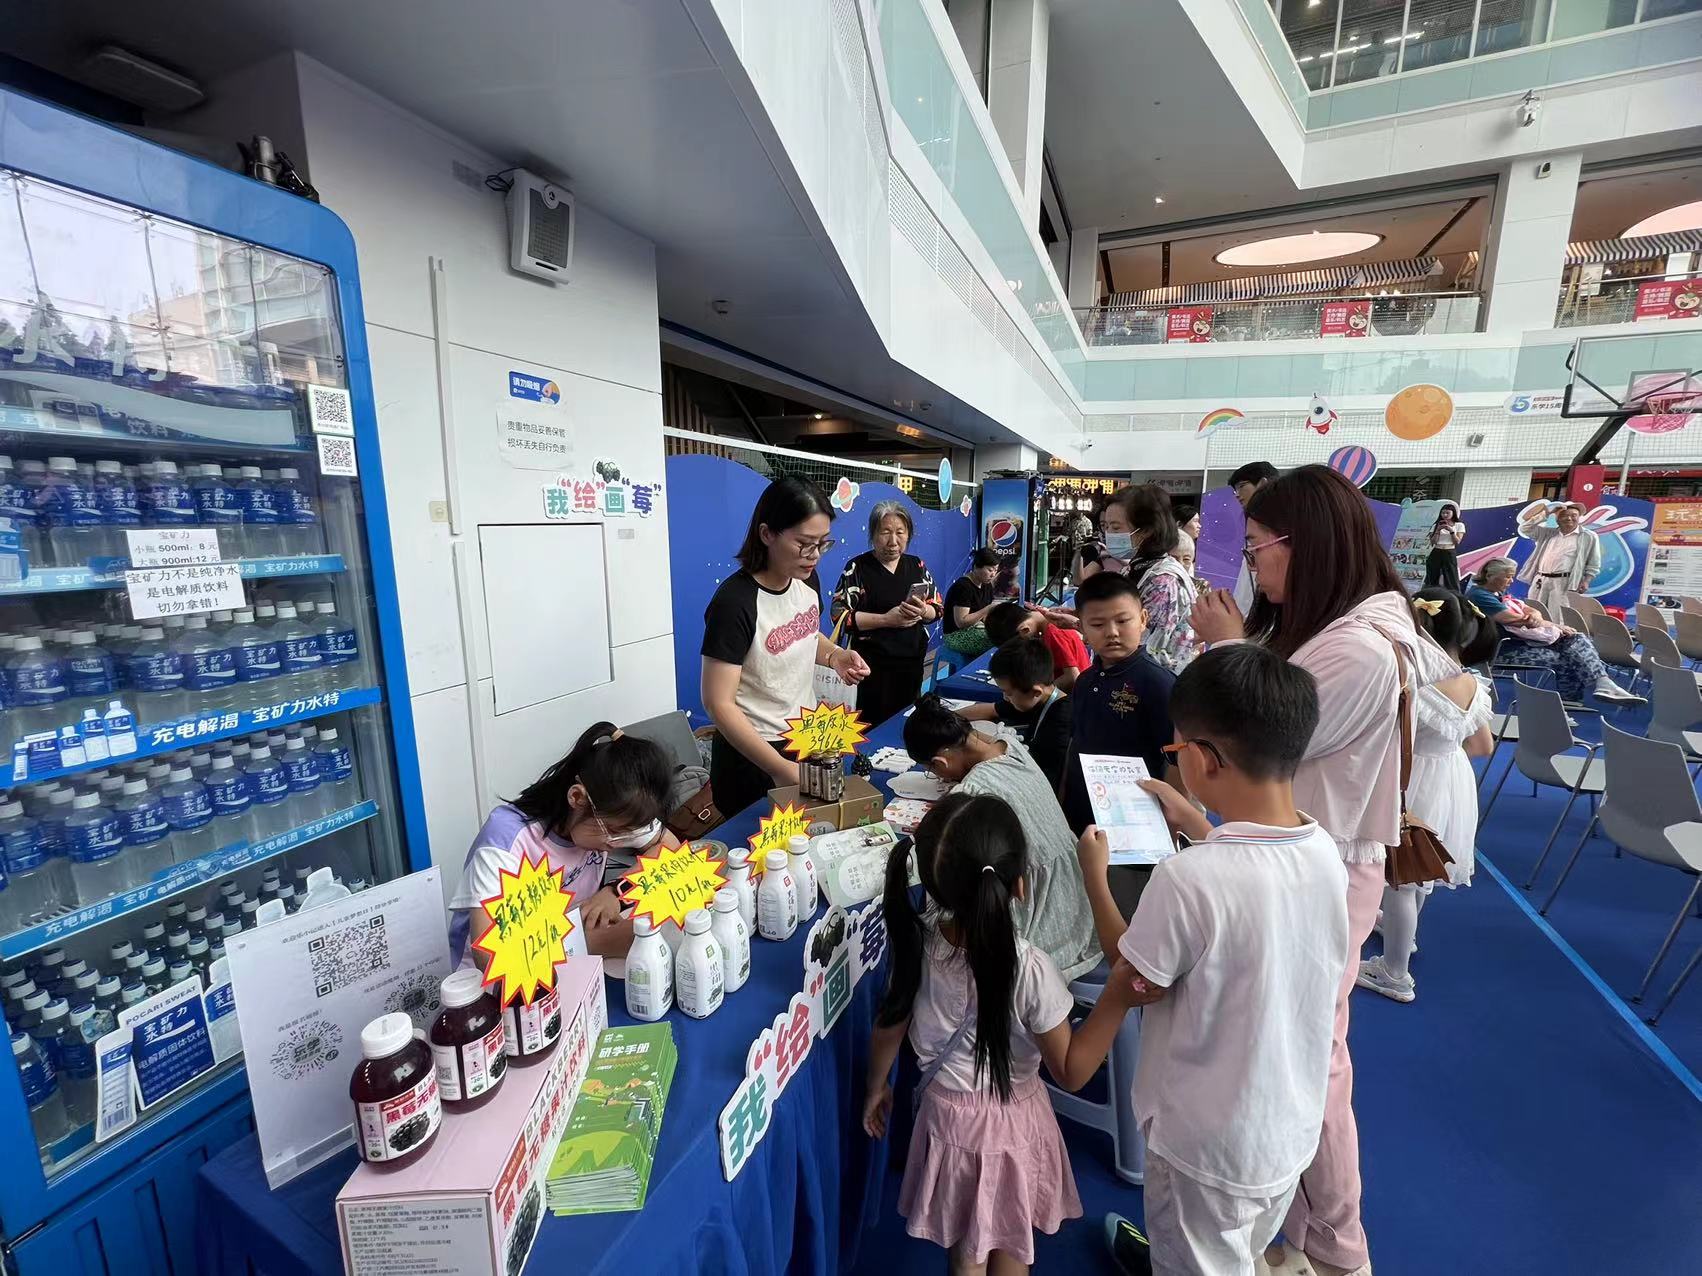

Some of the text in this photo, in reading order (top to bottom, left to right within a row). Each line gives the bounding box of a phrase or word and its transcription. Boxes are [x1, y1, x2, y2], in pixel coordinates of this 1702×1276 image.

[507, 420, 567, 438] 贵重物品妥善保管
[507, 438, 567, 454] 损坏丢失自行负责
[158, 531, 190, 540] 宝矿力
[199, 542, 206, 550] 8
[208, 542, 218, 550] 元
[210, 555, 220, 564] 元
[264, 560, 320, 573] 宝矿力水特
[126, 565, 239, 585] 宝矿力不是纯净水
[146, 582, 229, 599] 是电解质饮料
[151, 713, 239, 747] 充电解渴
[252, 692, 341, 723] 宝矿力水特
[45, 901, 113, 936] 充电解渴
[253, 831, 299, 855] 充电解渴
[304, 810, 355, 838] 宝矿力水特
[126, 985, 197, 1026] POCARI SWEAT
[144, 1006, 188, 1034] 宝矿力
[146, 1021, 174, 1043] 水特
[599, 1042, 650, 1058] 研学手册
[525, 1011, 584, 1144] BLACKBERRY
